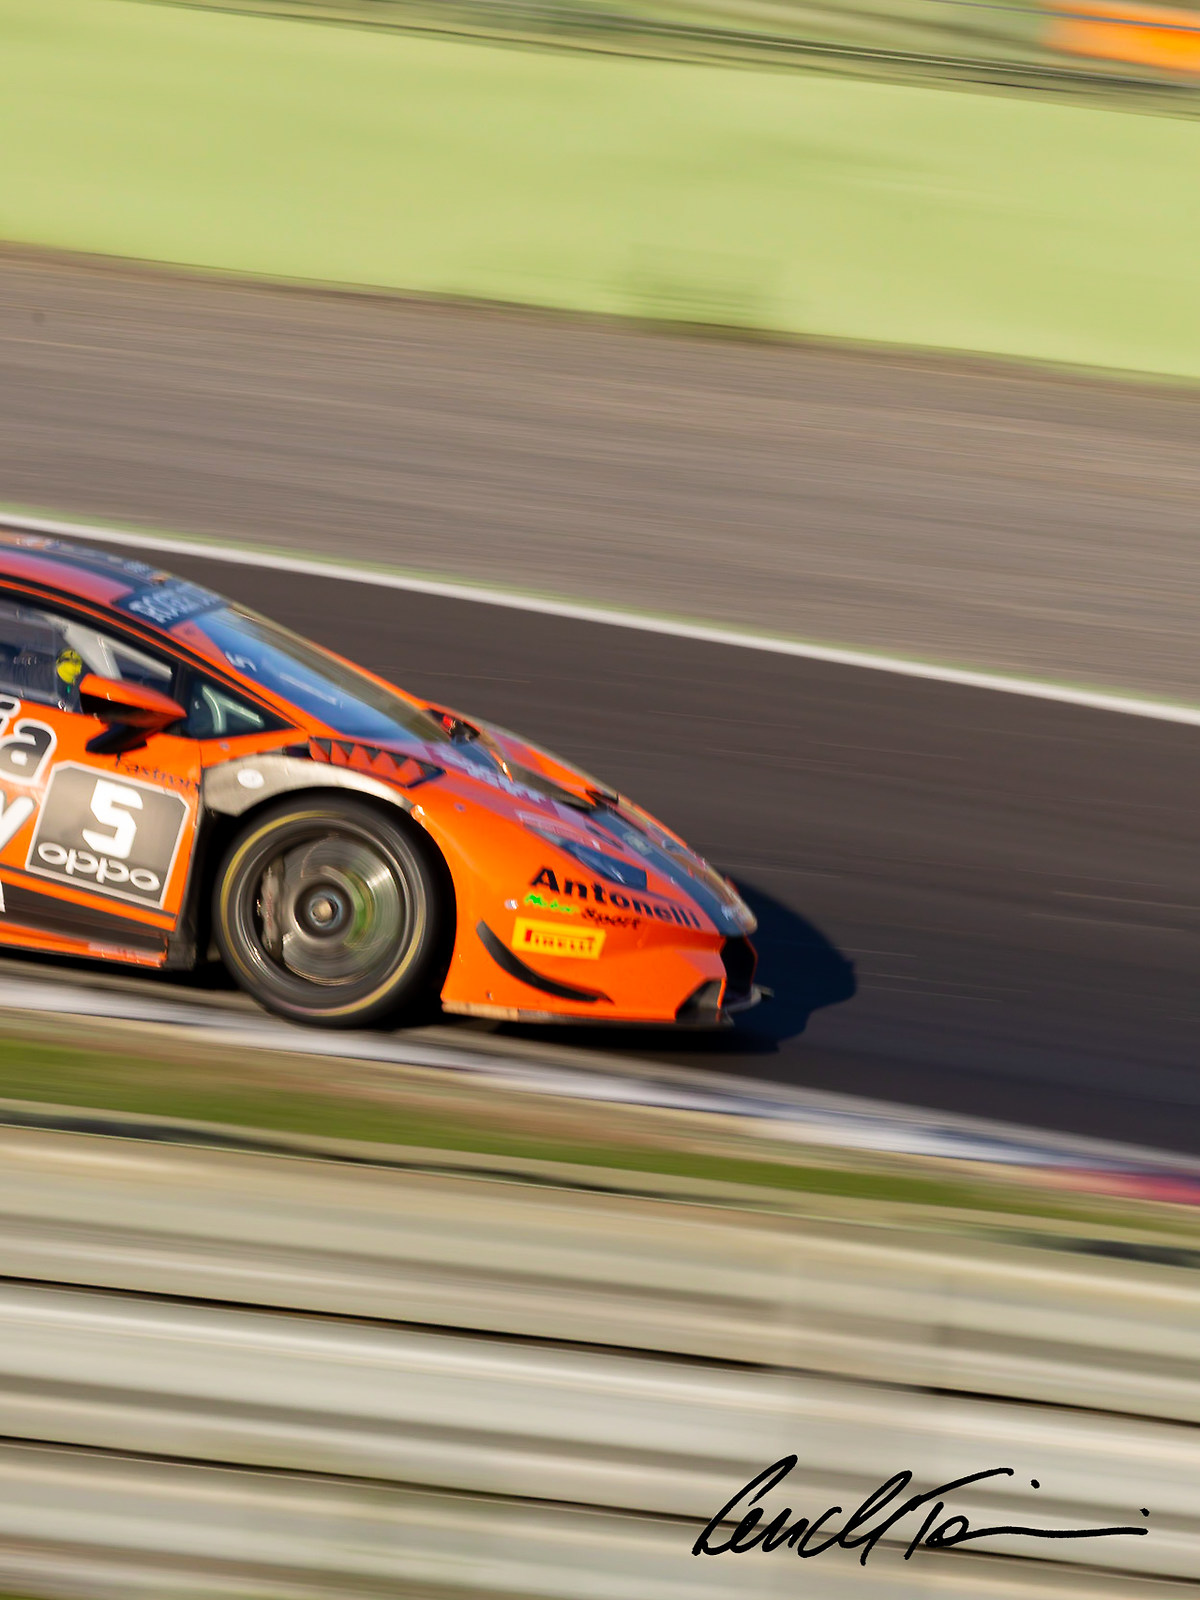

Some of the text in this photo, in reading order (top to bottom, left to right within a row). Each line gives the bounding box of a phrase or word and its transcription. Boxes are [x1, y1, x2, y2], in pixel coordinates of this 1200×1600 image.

[82, 778, 143, 859] 5
[38, 842, 160, 891] oppo
[530, 866, 700, 928] Antonelli
